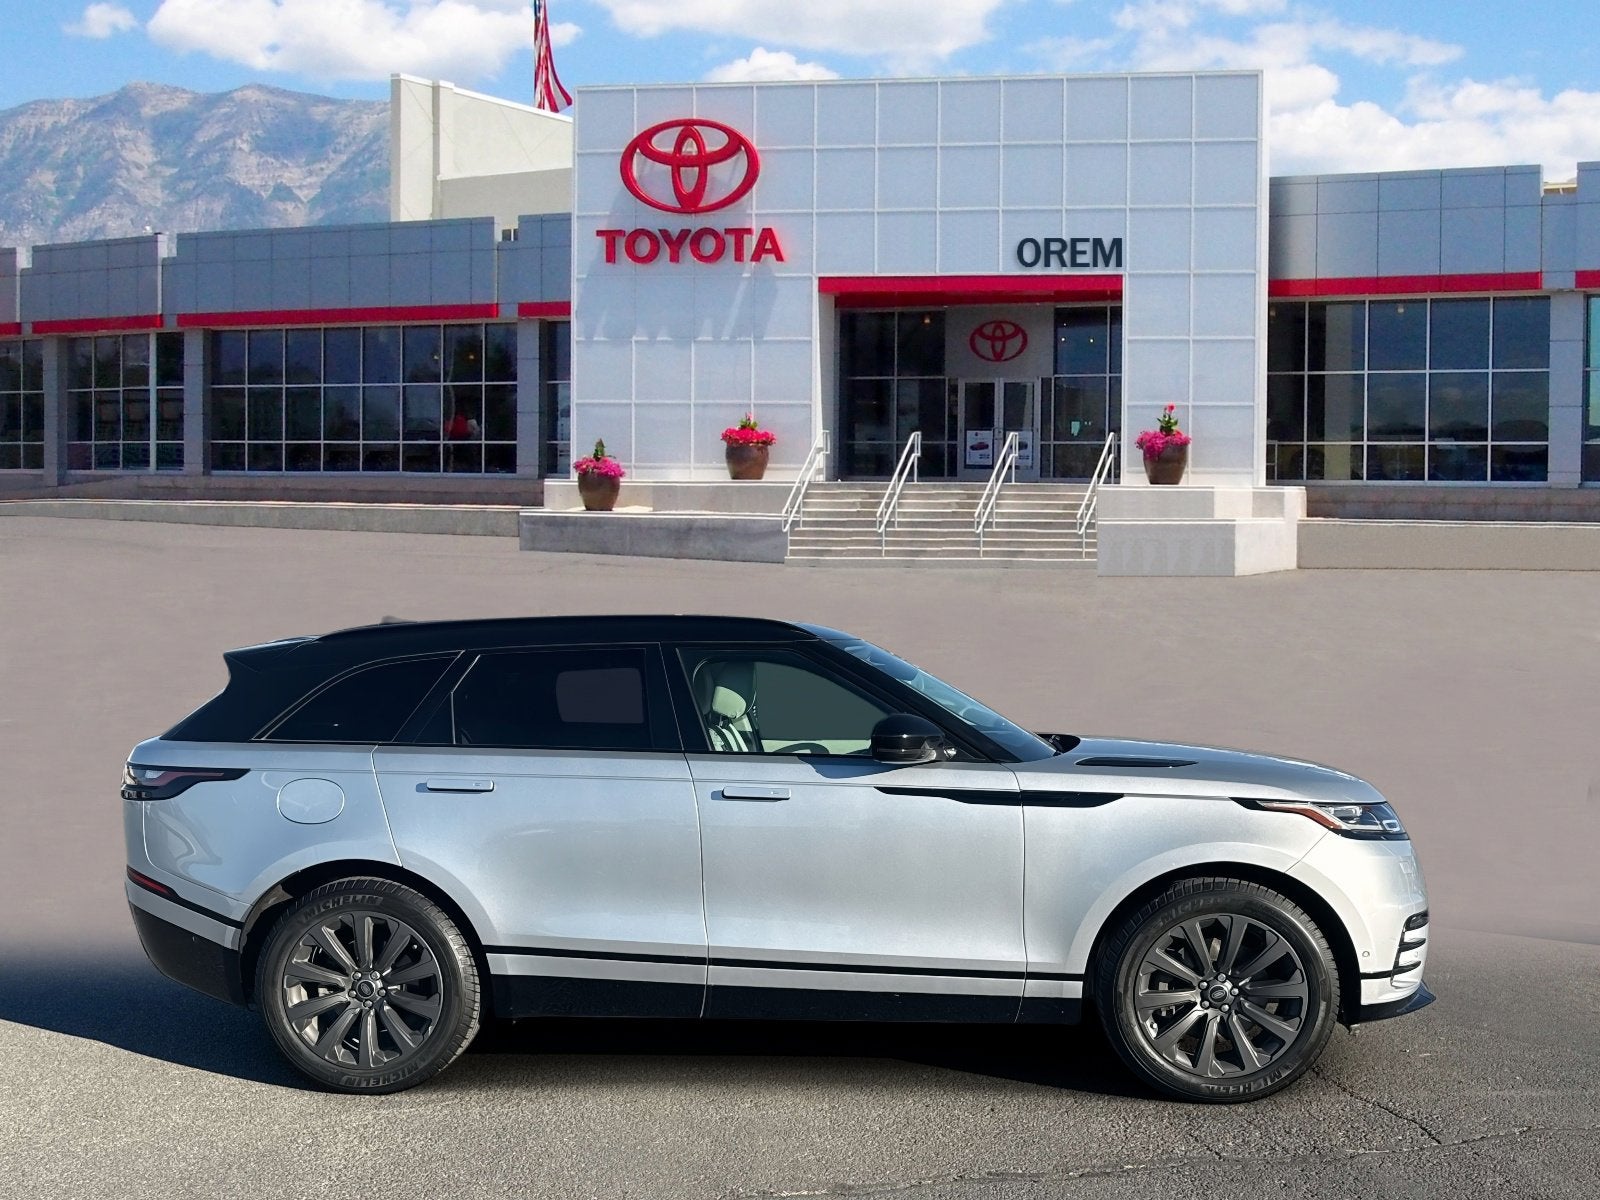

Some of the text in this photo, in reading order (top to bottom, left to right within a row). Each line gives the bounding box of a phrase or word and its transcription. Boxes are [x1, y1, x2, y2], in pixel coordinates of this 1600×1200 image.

[596, 227, 785, 264] TOYOTA
[1017, 237, 1122, 268] OREM
[303, 895, 383, 921] MICHELIN
[1161, 898, 1230, 925] MICHE
[342, 1061, 420, 1087] MICHELIN
